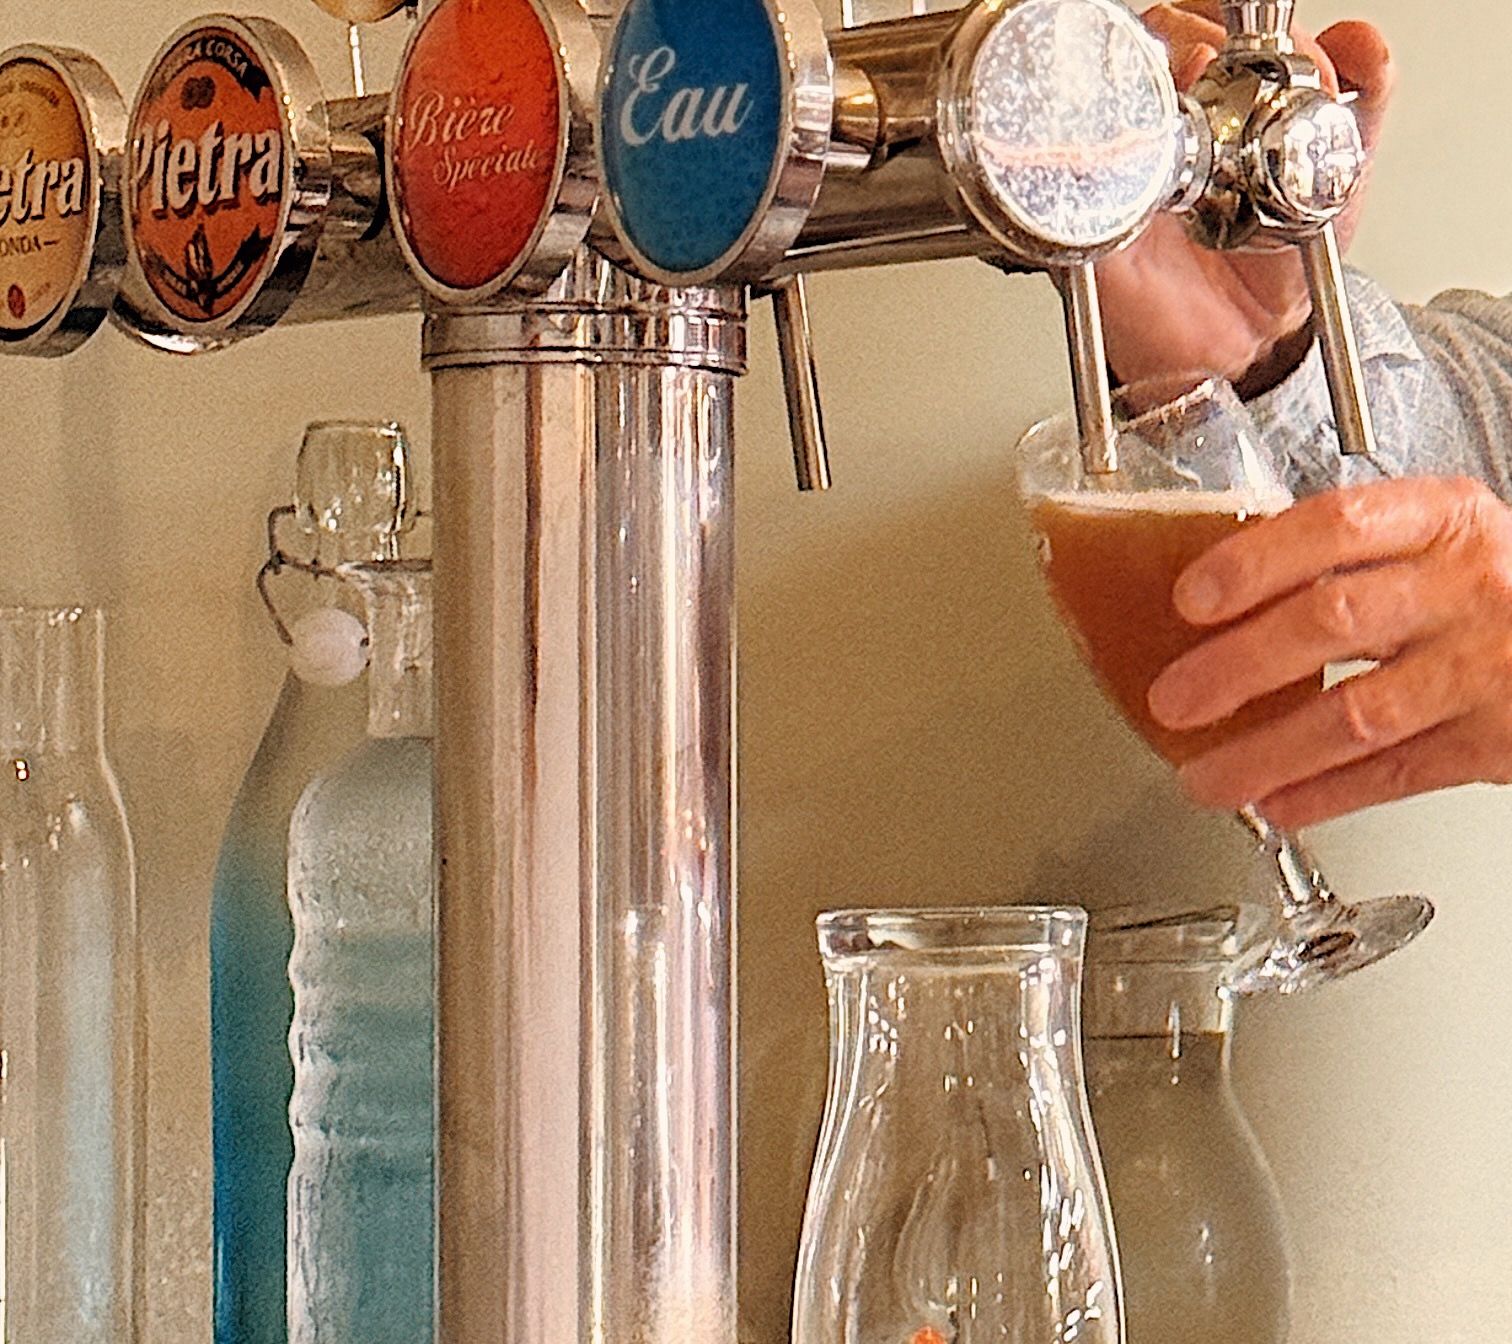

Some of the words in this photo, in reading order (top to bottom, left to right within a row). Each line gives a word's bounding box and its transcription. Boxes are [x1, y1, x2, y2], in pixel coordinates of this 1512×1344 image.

[404, 89, 516, 151] Bière
[620, 45, 755, 147] Eau
[0, 148, 85, 228] etra
[132, 118, 284, 216] Pietra
[0, 234, 42, 257] ONDA
